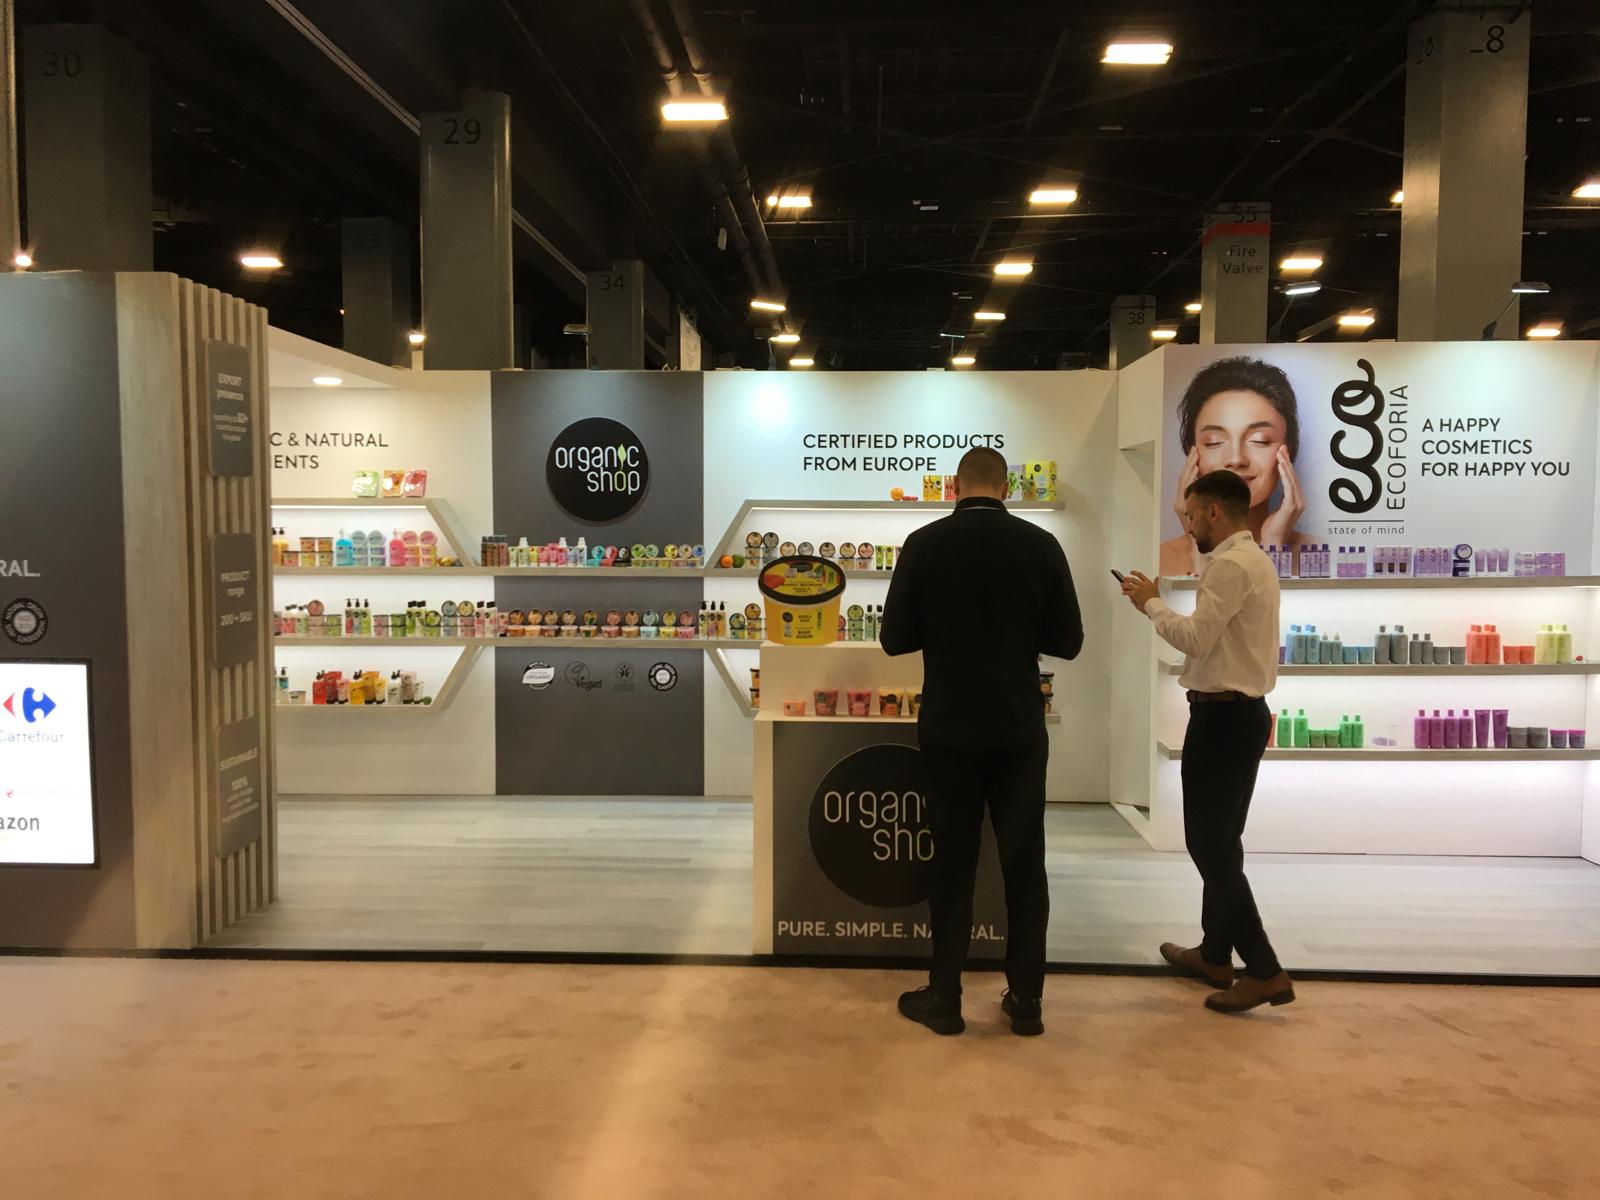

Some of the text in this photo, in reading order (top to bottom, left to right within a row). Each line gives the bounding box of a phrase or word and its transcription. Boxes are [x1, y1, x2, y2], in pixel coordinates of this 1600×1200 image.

[1469, 25, 1505, 53] 8
[43, 50, 82, 78] 30
[443, 118, 482, 145] 29
[1229, 244, 1257, 257] Fire
[1222, 261, 1264, 274] Valve
[600, 273, 626, 292] 34
[1127, 311, 1146, 325] 38
[1422, 417, 1501, 432] A HAPPY
[288, 432, 299, 446] &
[305, 432, 389, 447] NATURAL
[803, 434, 1005, 449] CERTIFIED PRODUCTS
[1387, 384, 1408, 510] ECOFORIA
[1422, 439, 1532, 455] COSMETICS
[555, 443, 640, 472] organic
[803, 456, 937, 471] FROM EUROPE
[1422, 461, 1570, 477] FOR HAPPY YOU
[587, 466, 640, 495] shop
[1328, 525, 1405, 535] state of mind
[0, 731, 64, 744] Carrefour
[824, 790, 927, 829] organ
[873, 821, 935, 862] sho
[777, 921, 830, 937] PURE.
[835, 922, 908, 938] SIMPLE.
